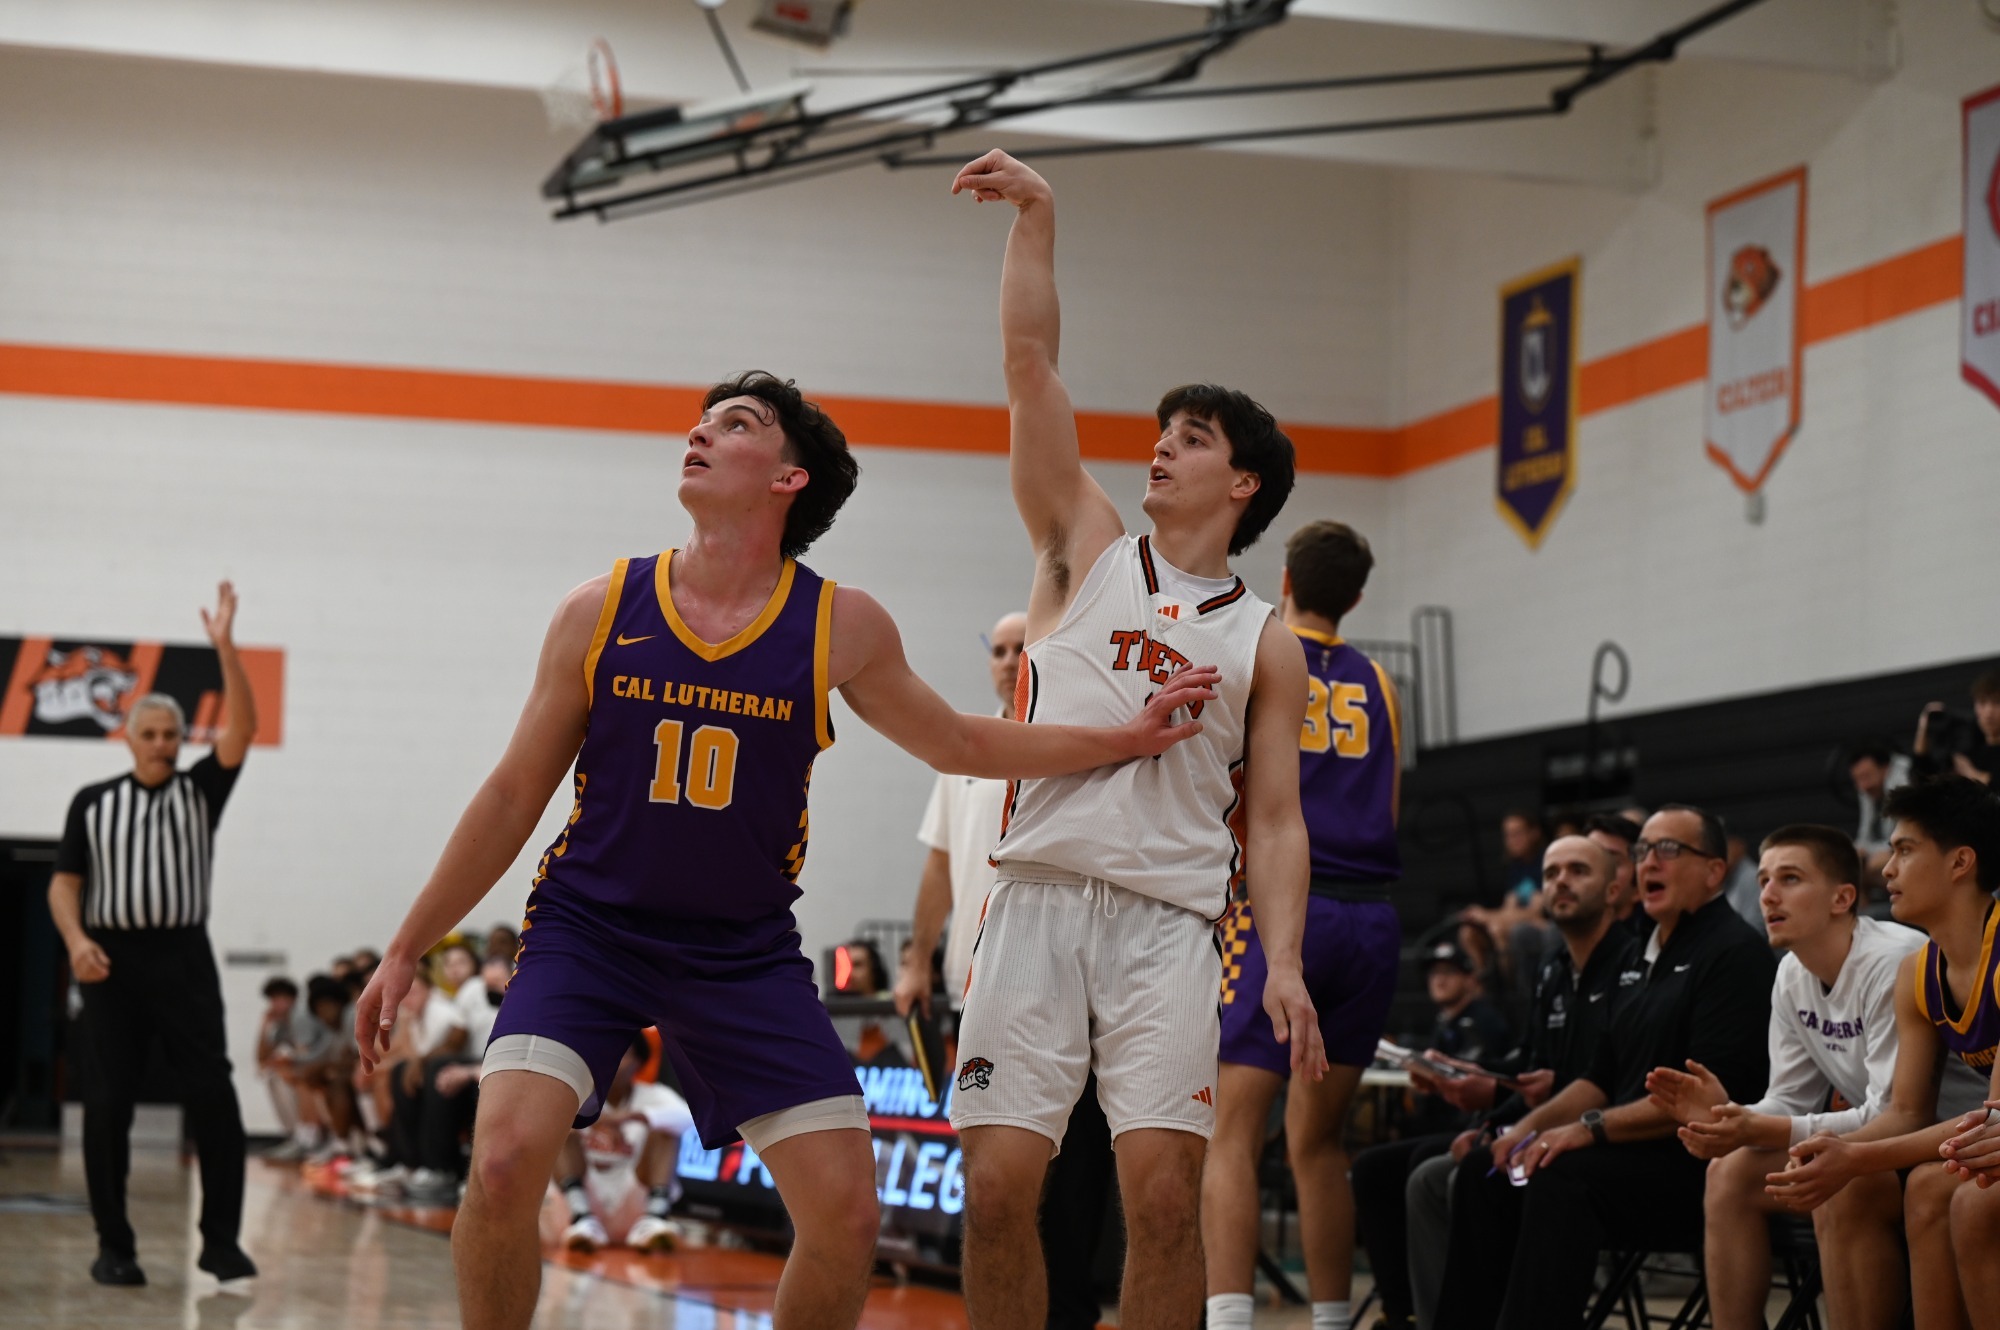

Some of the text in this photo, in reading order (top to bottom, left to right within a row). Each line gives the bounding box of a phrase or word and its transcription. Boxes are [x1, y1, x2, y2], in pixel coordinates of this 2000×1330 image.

[612, 675, 794, 722] CAL LUTHERAN
[1299, 674, 1370, 759] 35
[648, 718, 740, 811] 10
